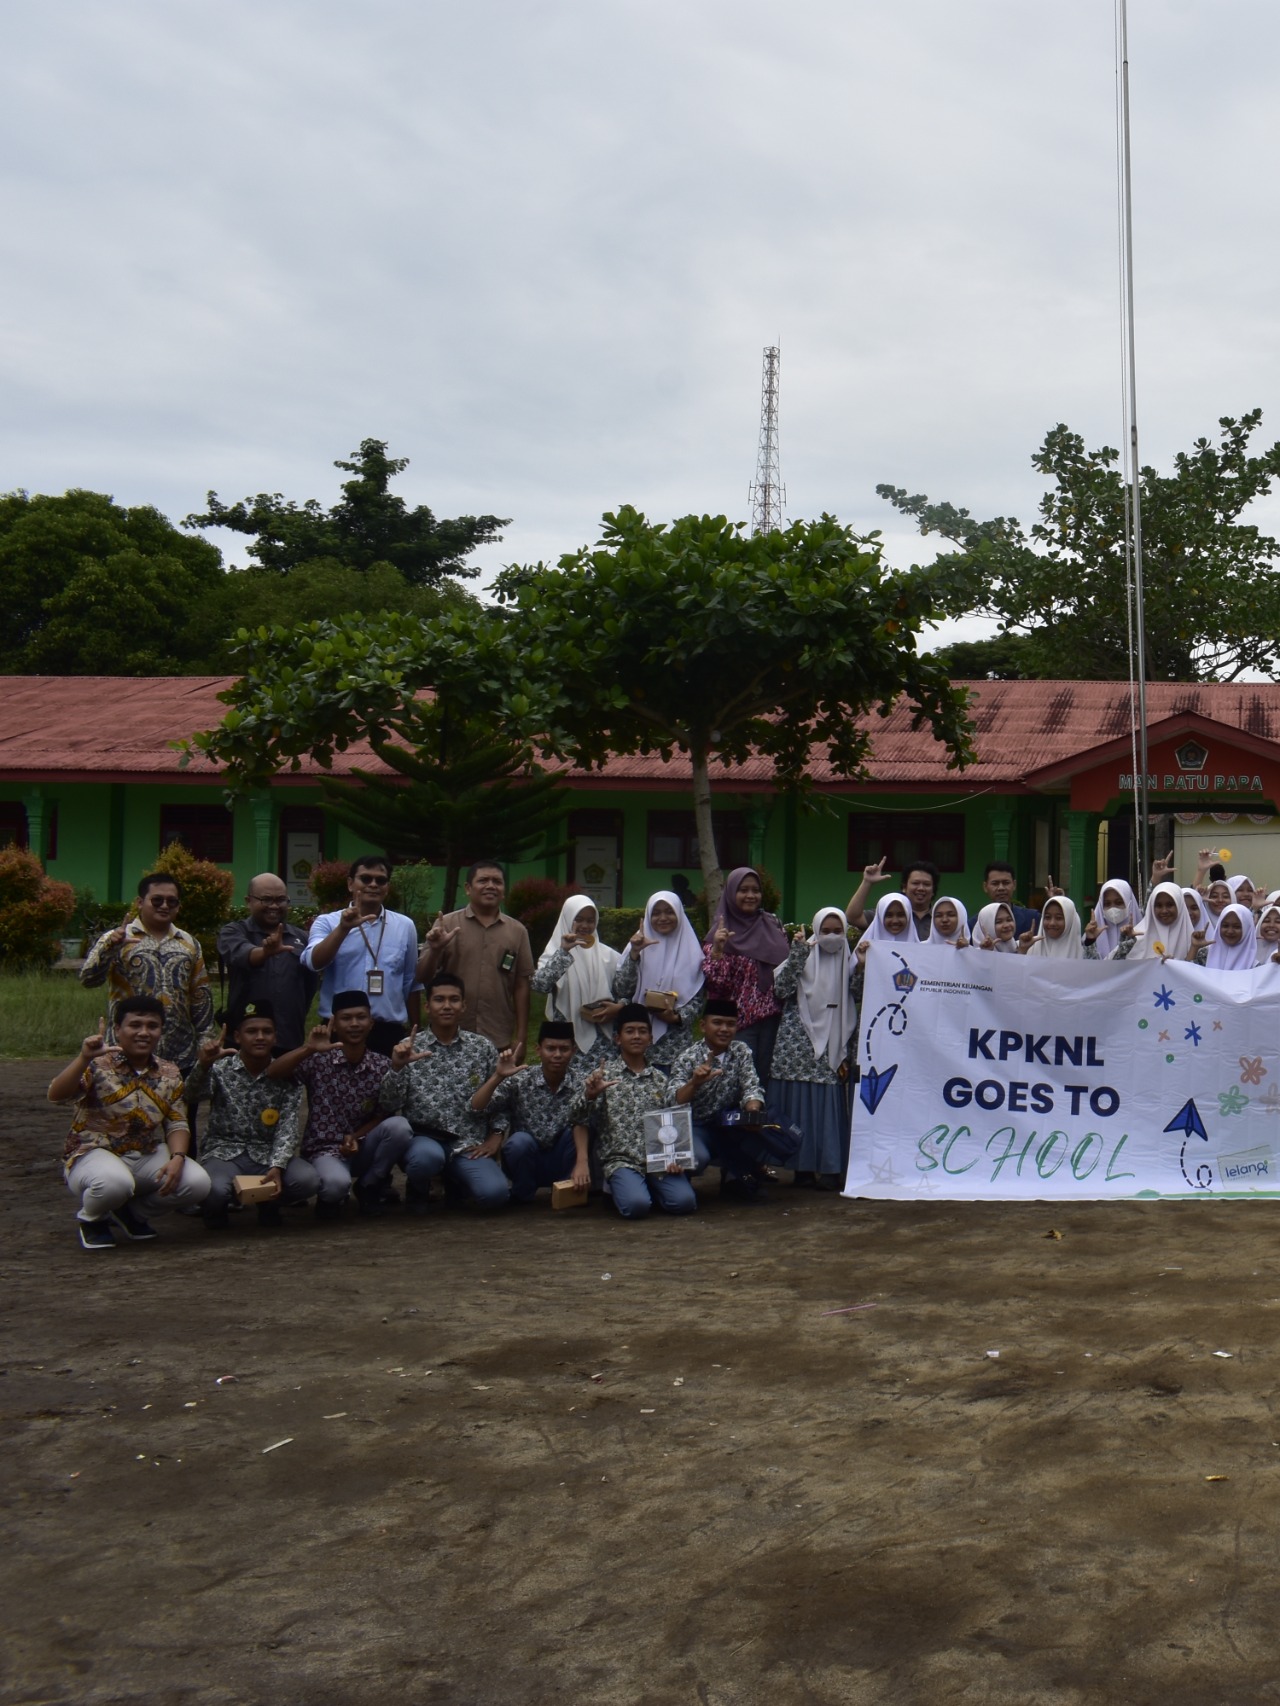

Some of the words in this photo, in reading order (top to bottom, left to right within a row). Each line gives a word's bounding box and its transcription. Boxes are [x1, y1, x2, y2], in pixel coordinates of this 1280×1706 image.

[1164, 774, 1209, 790] BATU
[920, 980, 961, 989] KEMENTERIAN
[961, 983, 993, 992] KEUANGAN
[968, 1028, 1105, 1067] KPKNL
[942, 1076, 1055, 1114] GOES
[1064, 1084, 1121, 1118] TO
